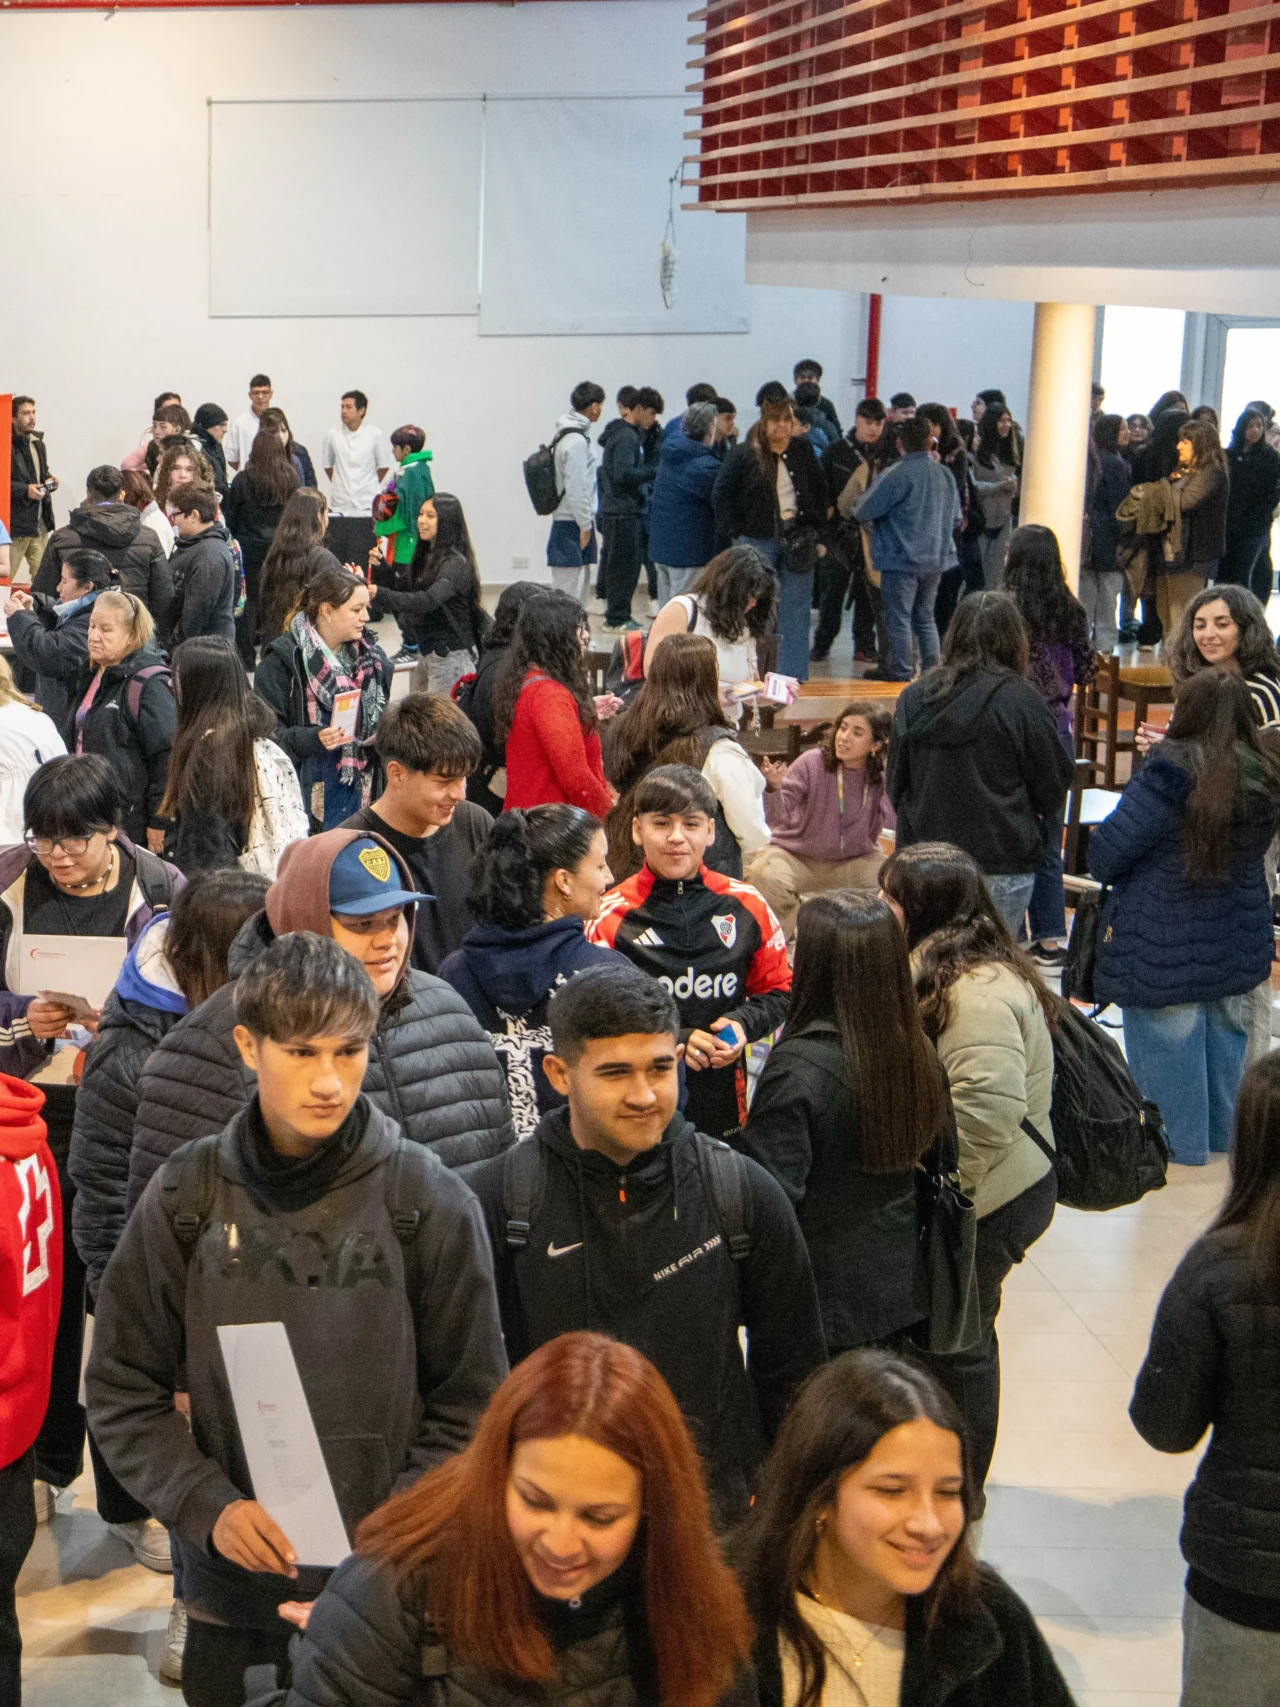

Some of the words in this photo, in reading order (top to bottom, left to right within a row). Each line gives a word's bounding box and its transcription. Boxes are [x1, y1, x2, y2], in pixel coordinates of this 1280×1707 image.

[658, 966, 739, 999] odere
[653, 1263, 678, 1281] NIKE
[678, 1247, 704, 1268] AIR
